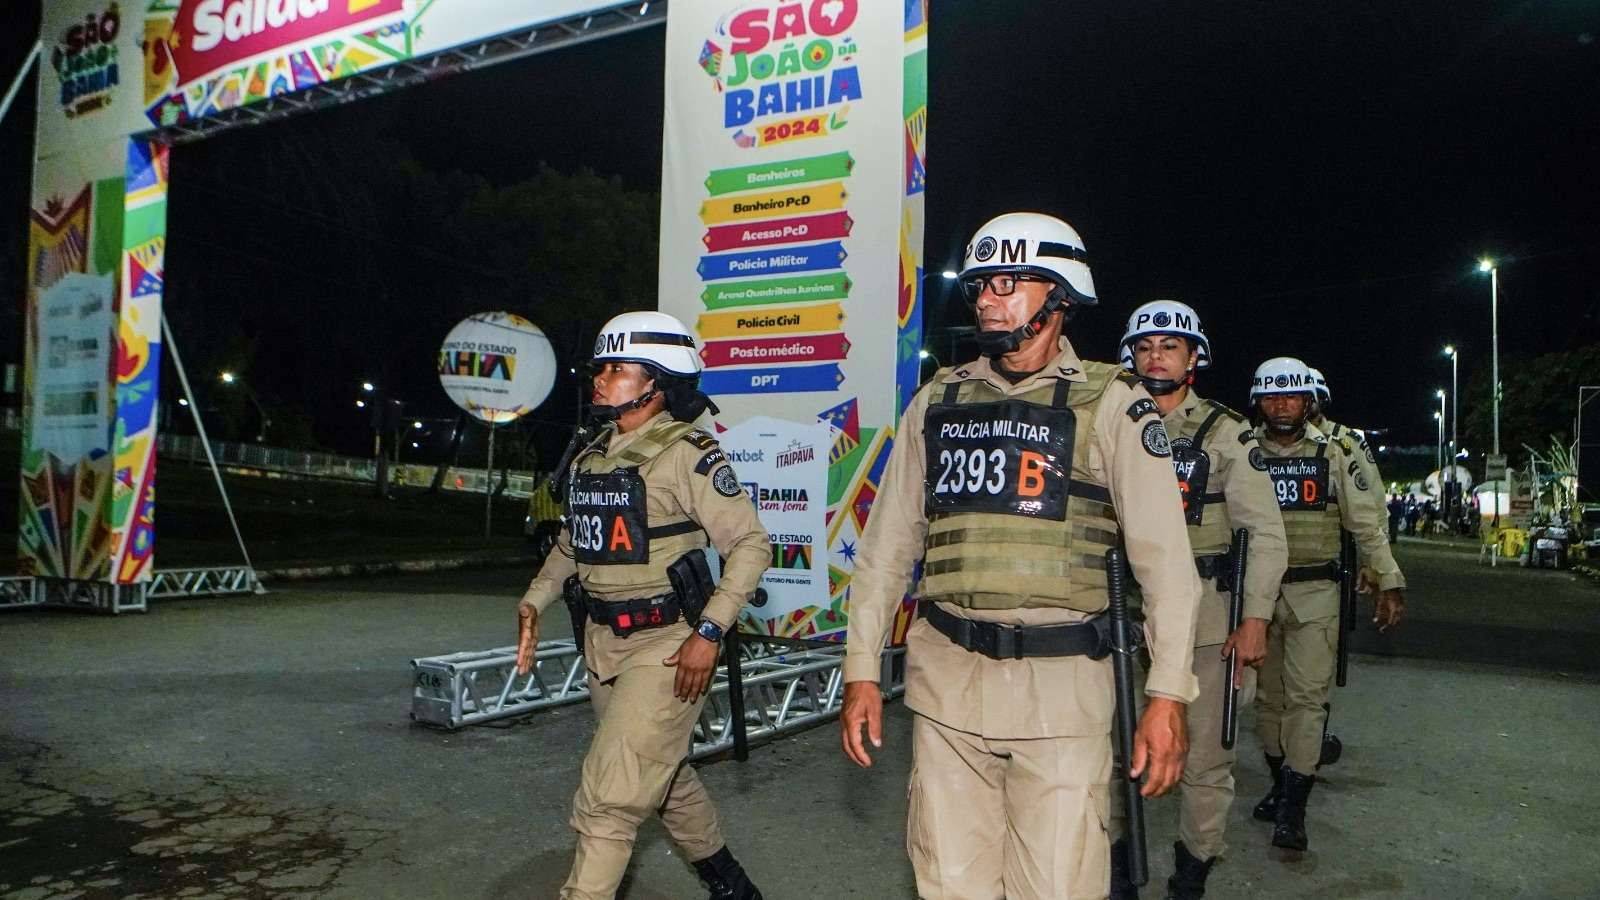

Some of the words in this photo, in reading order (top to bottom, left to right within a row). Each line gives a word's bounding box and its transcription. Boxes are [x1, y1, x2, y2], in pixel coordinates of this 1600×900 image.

[727, 39, 833, 86] JOÃO
[838, 44, 857, 56] DA
[724, 66, 862, 128] BAHIA
[764, 119, 820, 142] 2024
[747, 168, 805, 183] Banheiros
[733, 200, 784, 213] Banheiro
[786, 196, 810, 207] PcD
[742, 230, 782, 241] Acesso
[783, 225, 808, 237] PcD
[769, 255, 809, 267] Militar
[777, 314, 800, 325] Civil
[478, 343, 517, 355] ESTADO
[730, 346, 767, 358] Posto
[768, 343, 815, 356] médico
[751, 375, 779, 387] DPT
[940, 419, 990, 439] POLÍCIA
[992, 419, 1050, 443] MILITAR
[776, 448, 814, 468] ITAIPAVA
[934, 448, 1007, 495] 2393
[1017, 450, 1047, 497] B
[1286, 464, 1317, 475] MILITAR
[590, 491, 630, 506] MILITAR
[759, 489, 808, 501] BAHIA
[1302, 480, 1317, 502] D
[782, 501, 808, 512] fome
[610, 515, 632, 551] A
[779, 534, 813, 544] ESTADO
